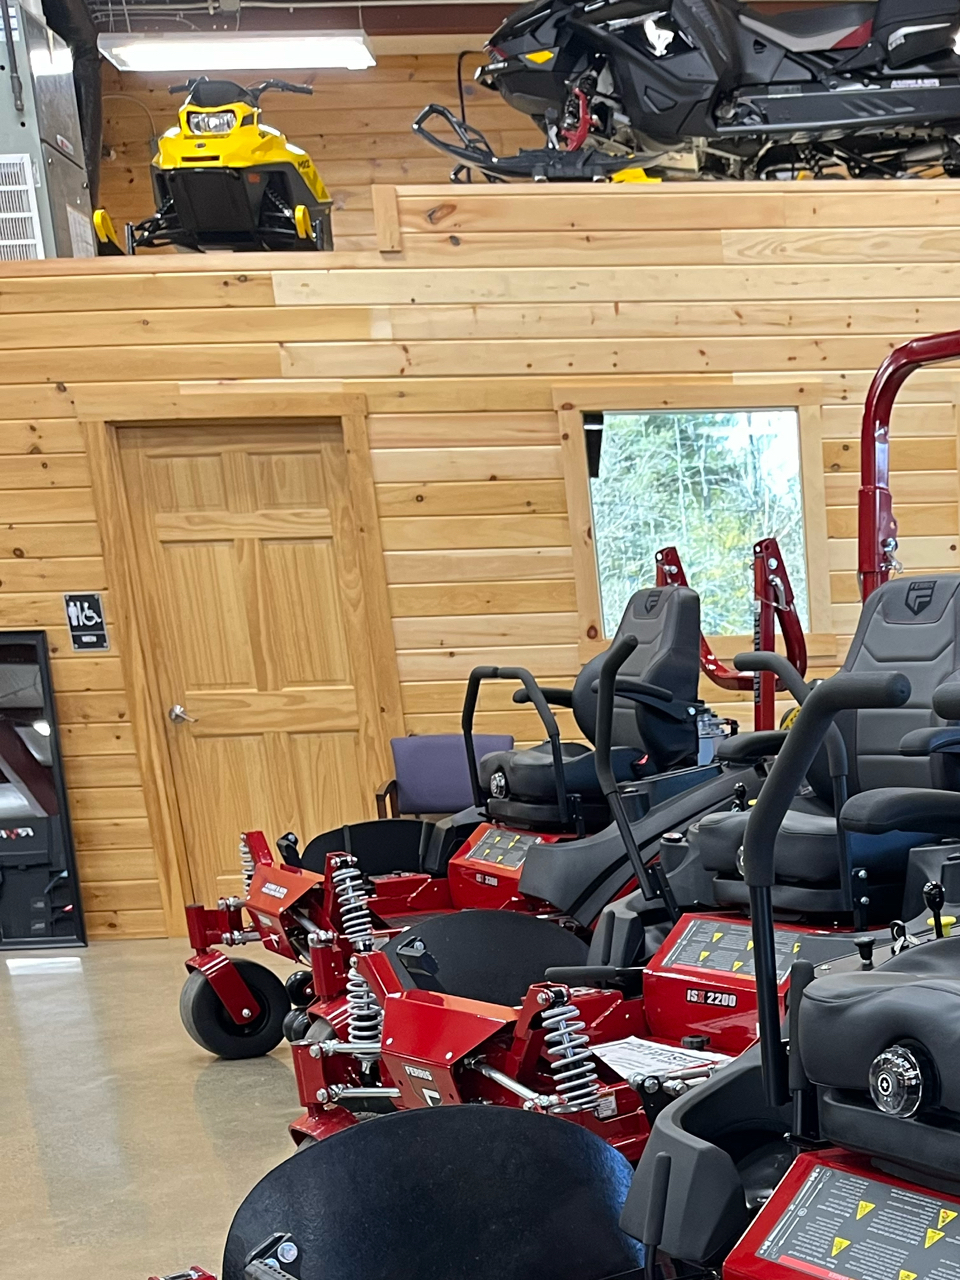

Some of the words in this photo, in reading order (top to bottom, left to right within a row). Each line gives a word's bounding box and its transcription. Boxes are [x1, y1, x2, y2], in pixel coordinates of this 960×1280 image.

[687, 989, 705, 1003] ISX
[707, 992, 737, 1007] 2200
[828, 1272, 849, 1280] DANGER
